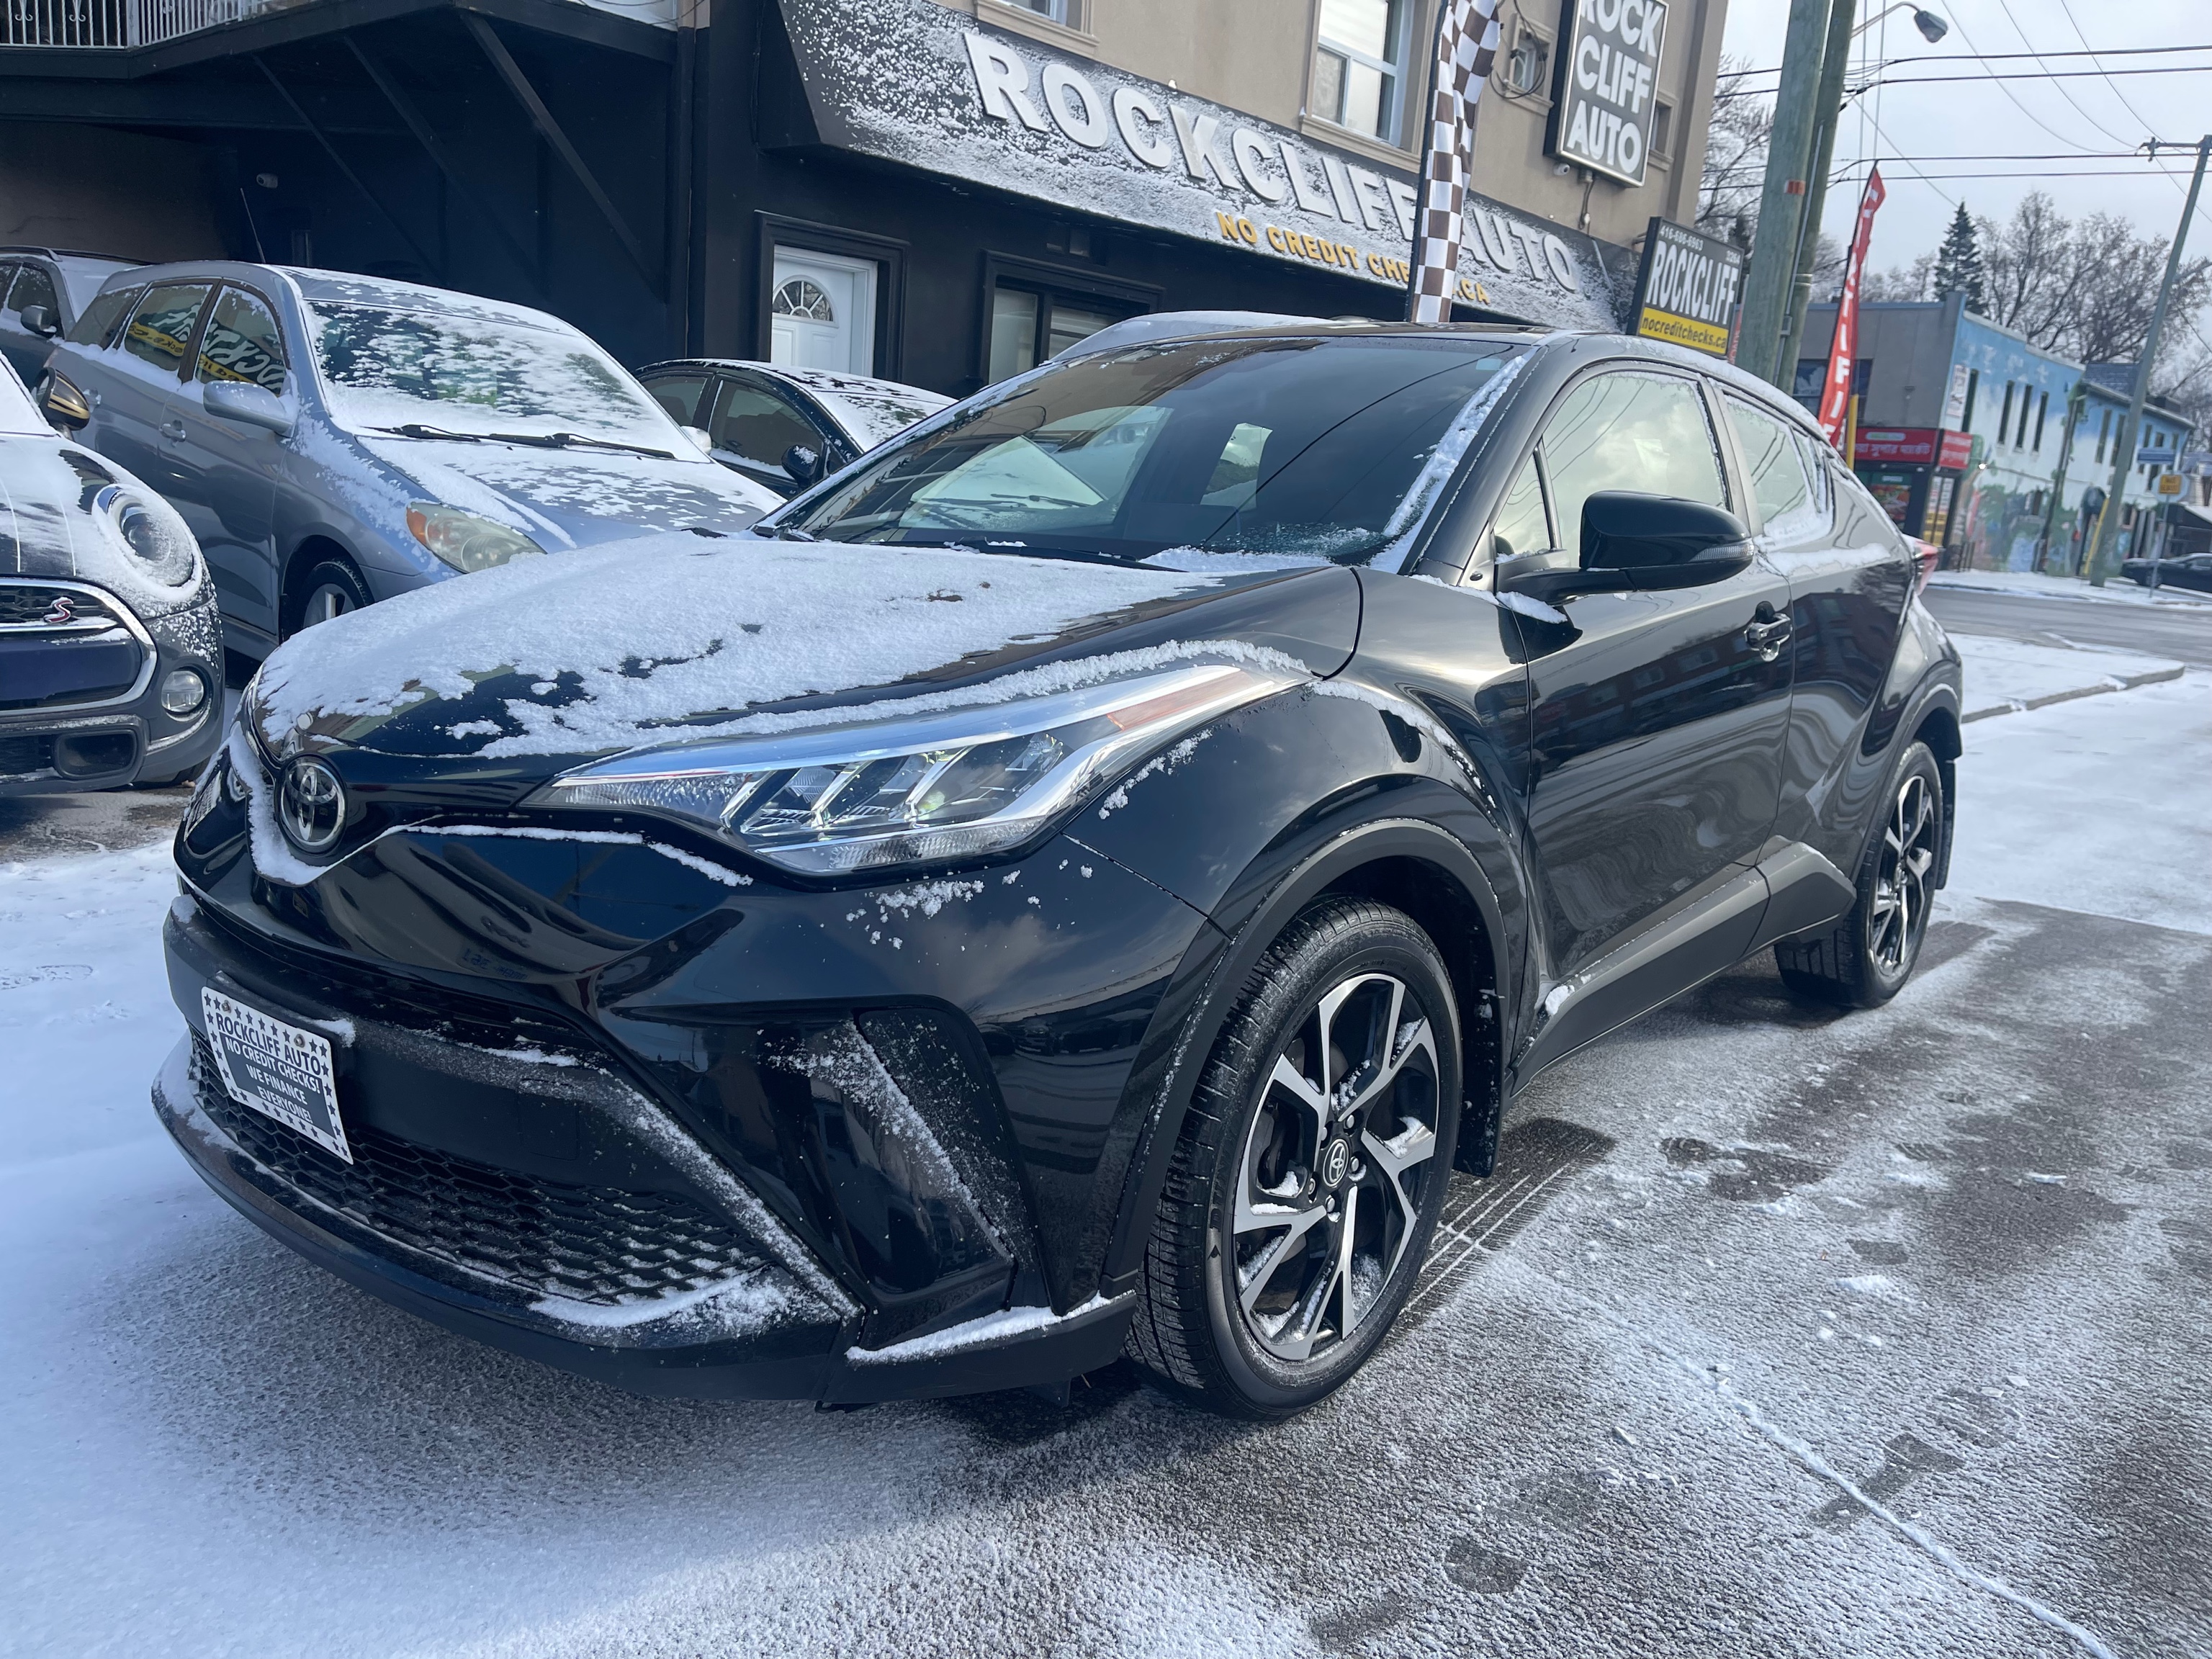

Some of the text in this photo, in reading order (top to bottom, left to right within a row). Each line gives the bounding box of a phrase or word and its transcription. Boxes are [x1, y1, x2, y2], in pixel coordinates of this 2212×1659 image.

[1576, 35, 1652, 114] CLIFF
[963, 32, 1417, 241] ROCKCLIFF
[1567, 99, 1642, 173] AUTO
[1217, 212, 1258, 244] NO
[1267, 225, 1359, 270] CREDIT
[1646, 240, 1739, 325] ROCKCLIFF
[1642, 316, 1727, 349] nocreditchecks.ca
[216, 1012, 321, 1075] ROCKCLIFF AUTO
[225, 1037, 320, 1094] NO CREDIT CHECKS!
[246, 1063, 308, 1105] WE FINANCE
[256, 1086, 313, 1123] EVERYONE!
